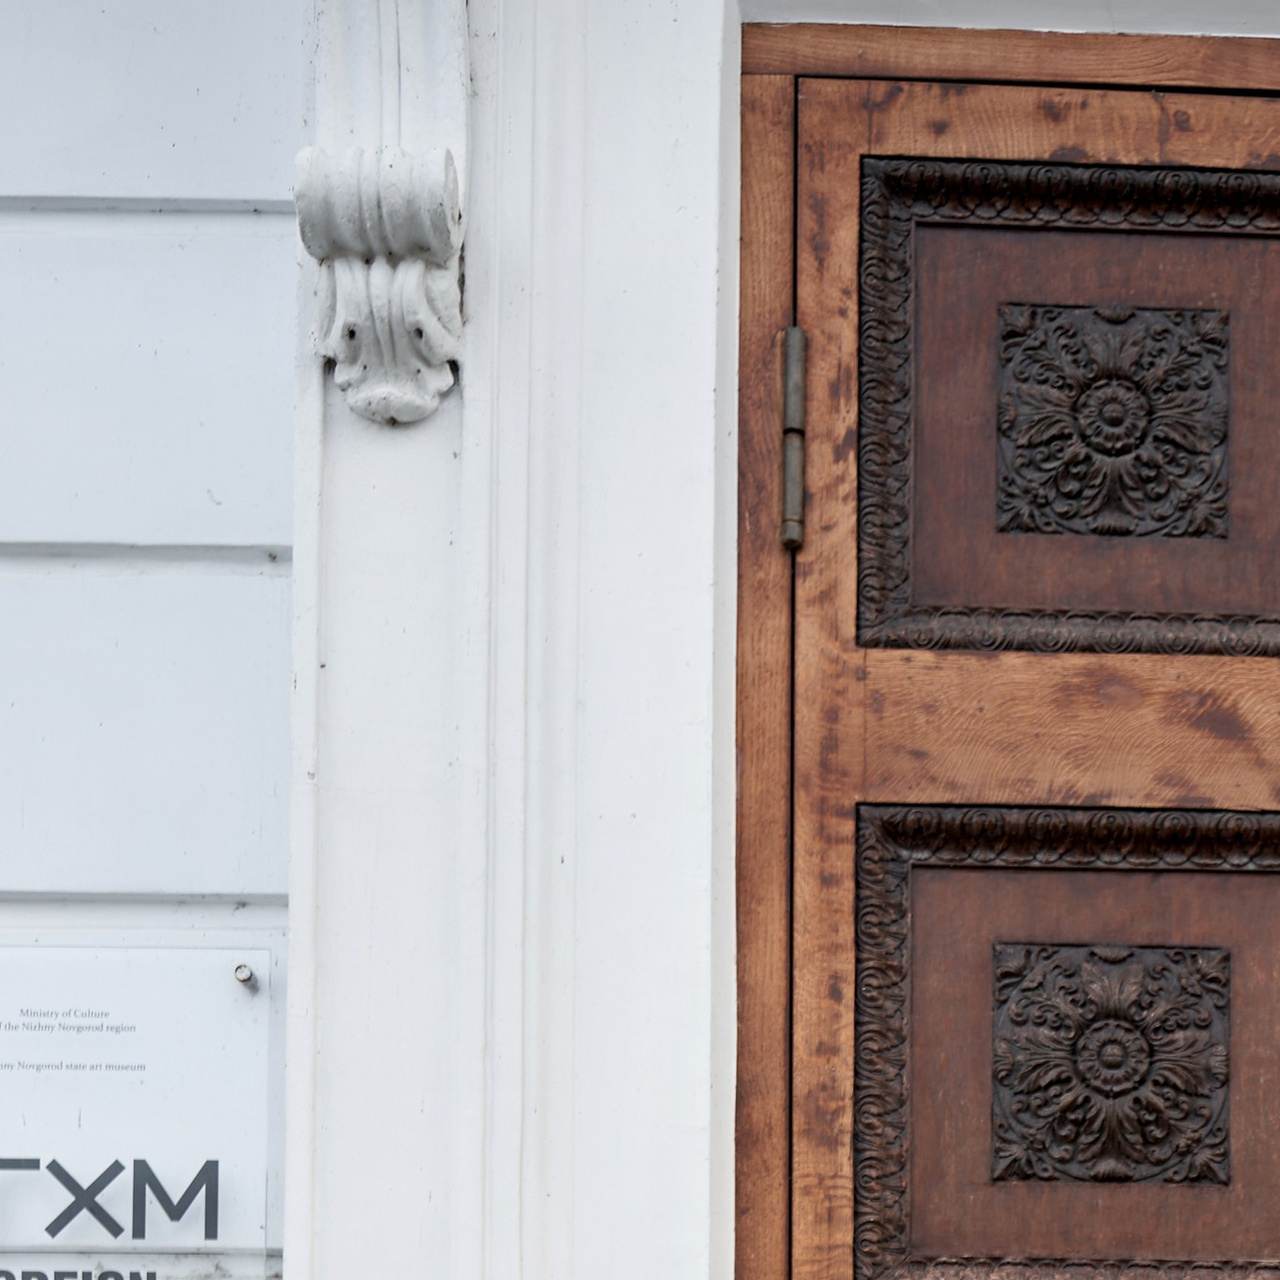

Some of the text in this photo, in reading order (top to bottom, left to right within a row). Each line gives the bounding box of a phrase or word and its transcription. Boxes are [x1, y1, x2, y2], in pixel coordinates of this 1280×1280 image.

[20, 1008, 110, 1020] Ministry of Culture
[4, 1021, 19, 1031] the
[22, 1022, 55, 1034] Nizhny
[58, 1022, 103, 1034] Novgorod
[106, 1023, 136, 1034] region
[18, 1061, 63, 1072] Novgorod
[65, 1062, 87, 1071] state
[89, 1063, 102, 1071] art
[105, 1063, 146, 1071] museum
